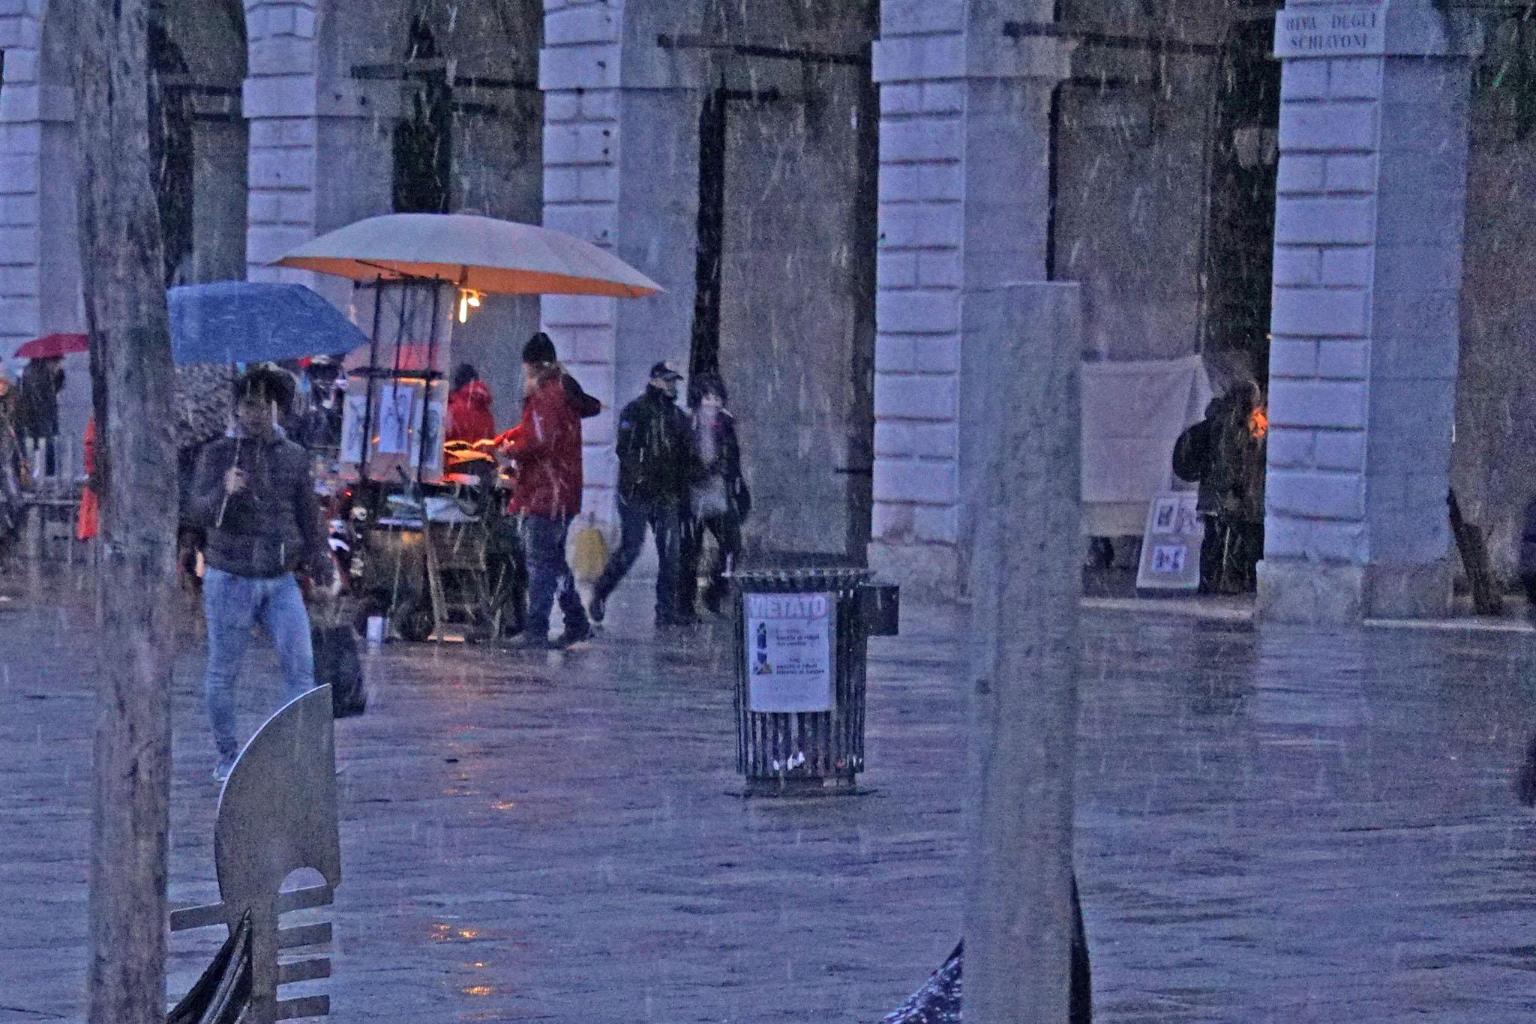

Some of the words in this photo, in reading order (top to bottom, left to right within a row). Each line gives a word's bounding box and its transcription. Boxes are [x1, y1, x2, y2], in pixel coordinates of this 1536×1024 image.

[1286, 16, 1316, 31] RIVA
[1331, 12, 1376, 29] DEGLI
[1289, 33, 1367, 50] SCHIAVONI
[749, 596, 827, 619] VIETATO
